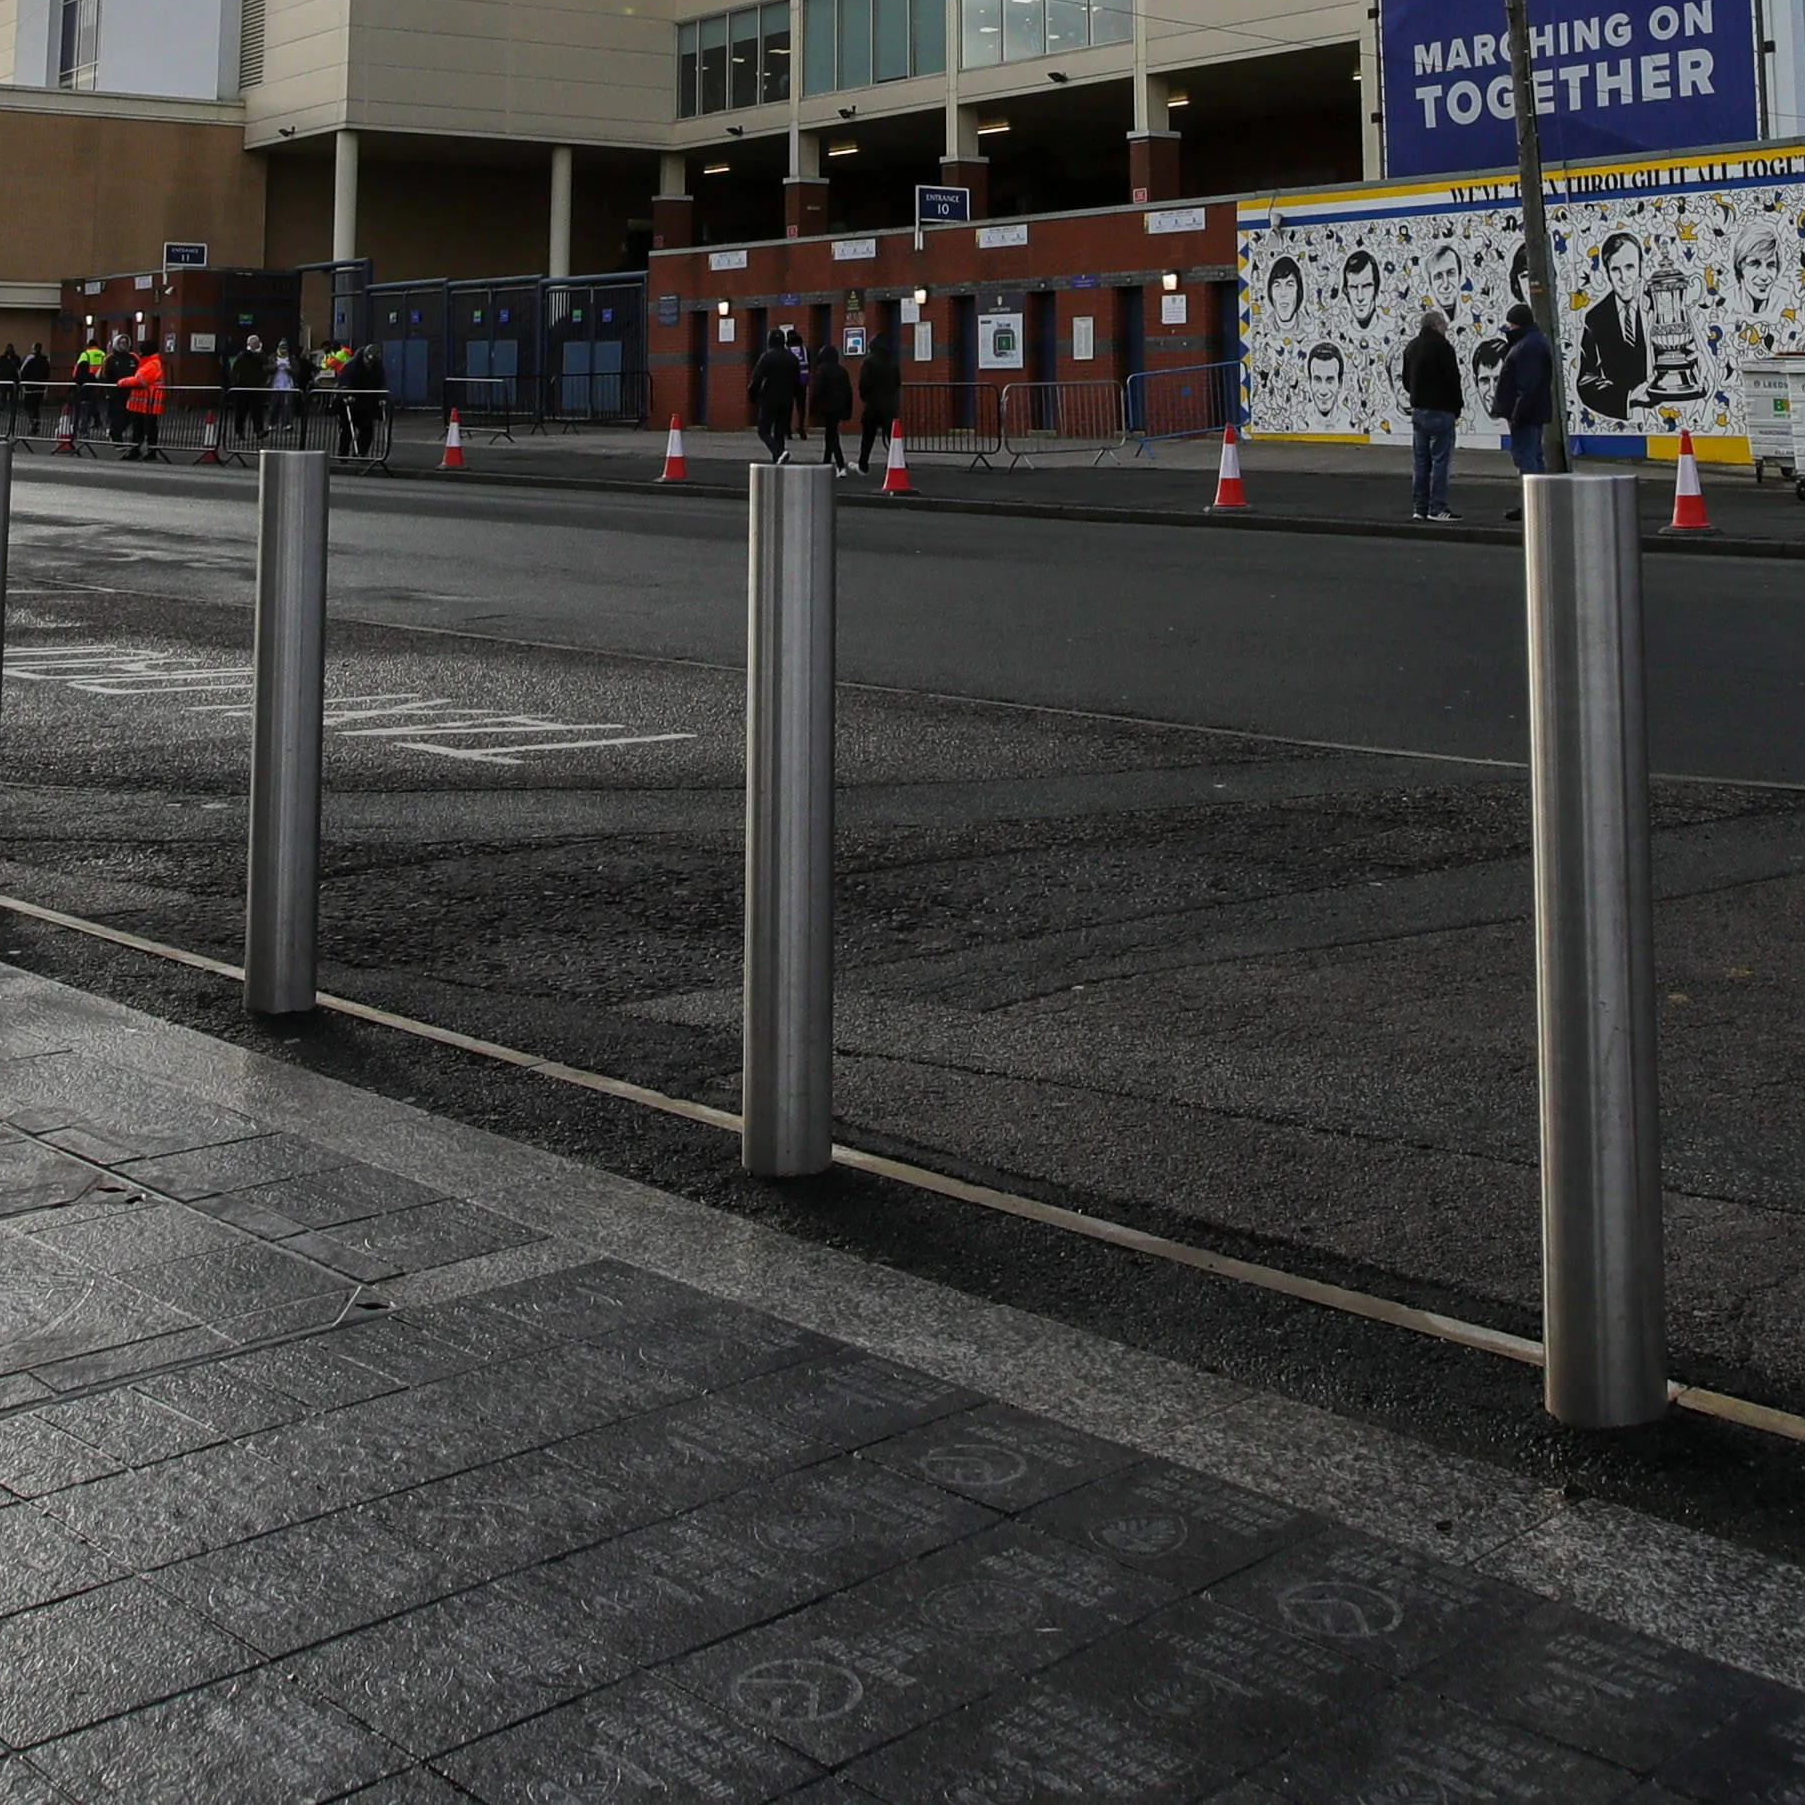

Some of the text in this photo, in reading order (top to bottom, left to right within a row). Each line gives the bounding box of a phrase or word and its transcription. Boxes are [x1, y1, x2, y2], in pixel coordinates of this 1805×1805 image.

[1415, 47, 1715, 129] TOGETHER
[1565, 167, 1661, 194] THROUGH
[1668, 165, 1690, 186] IT
[1696, 162, 1735, 182] ALL
[925, 193, 960, 204] ENTRANCE
[936, 203, 950, 215] 10
